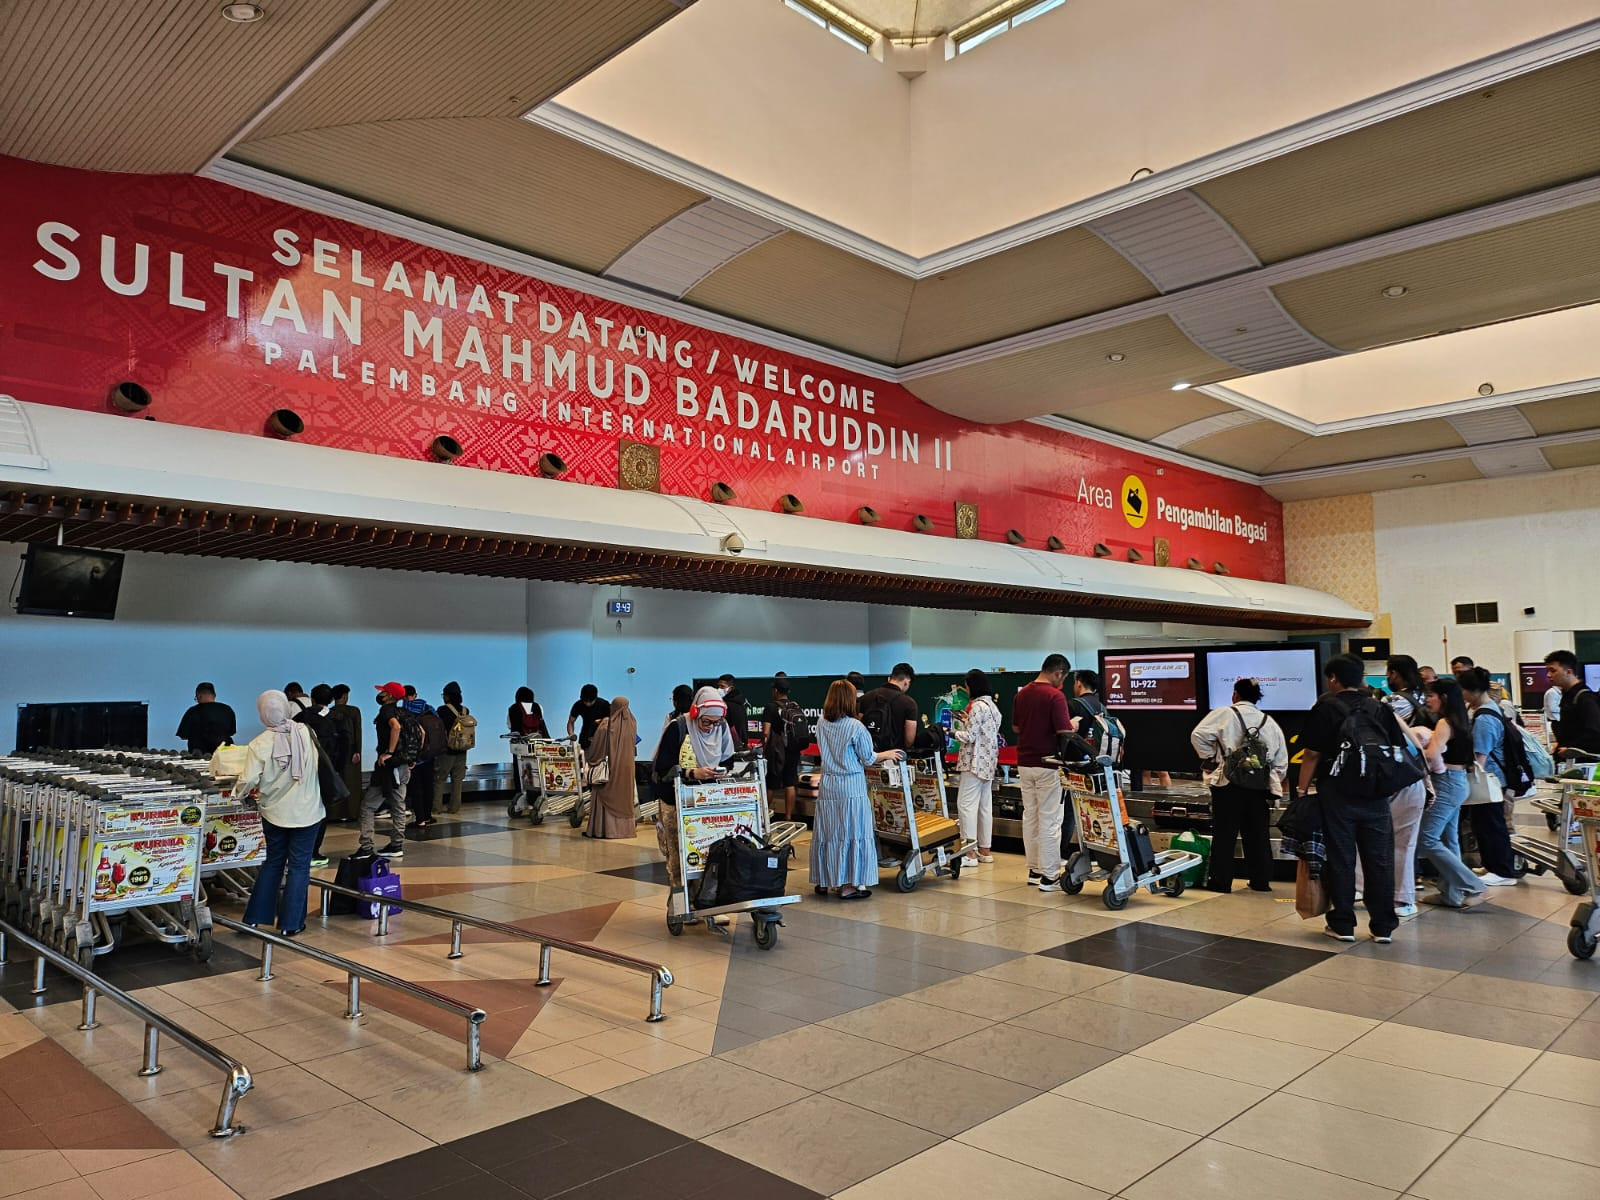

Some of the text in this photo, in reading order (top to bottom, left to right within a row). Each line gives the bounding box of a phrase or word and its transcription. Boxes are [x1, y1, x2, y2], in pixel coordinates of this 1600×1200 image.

[271, 228, 875, 414] SELAMAT DATANG / WELCOME
[32, 221, 952, 471] SULTAN MAHMUD BADARUDDIN II
[264, 342, 879, 480] PALEMBANG INTERNATIONAL AIRPORT
[1077, 477, 1113, 509] Area
[1157, 497, 1267, 544] Pengambilan Bagasi
[1111, 673, 1121, 689] 2
[1130, 680, 1157, 688] IU-922
[1526, 677, 1534, 686] 3
[133, 837, 184, 851] KURNIA
[130, 875, 148, 883] 1969
